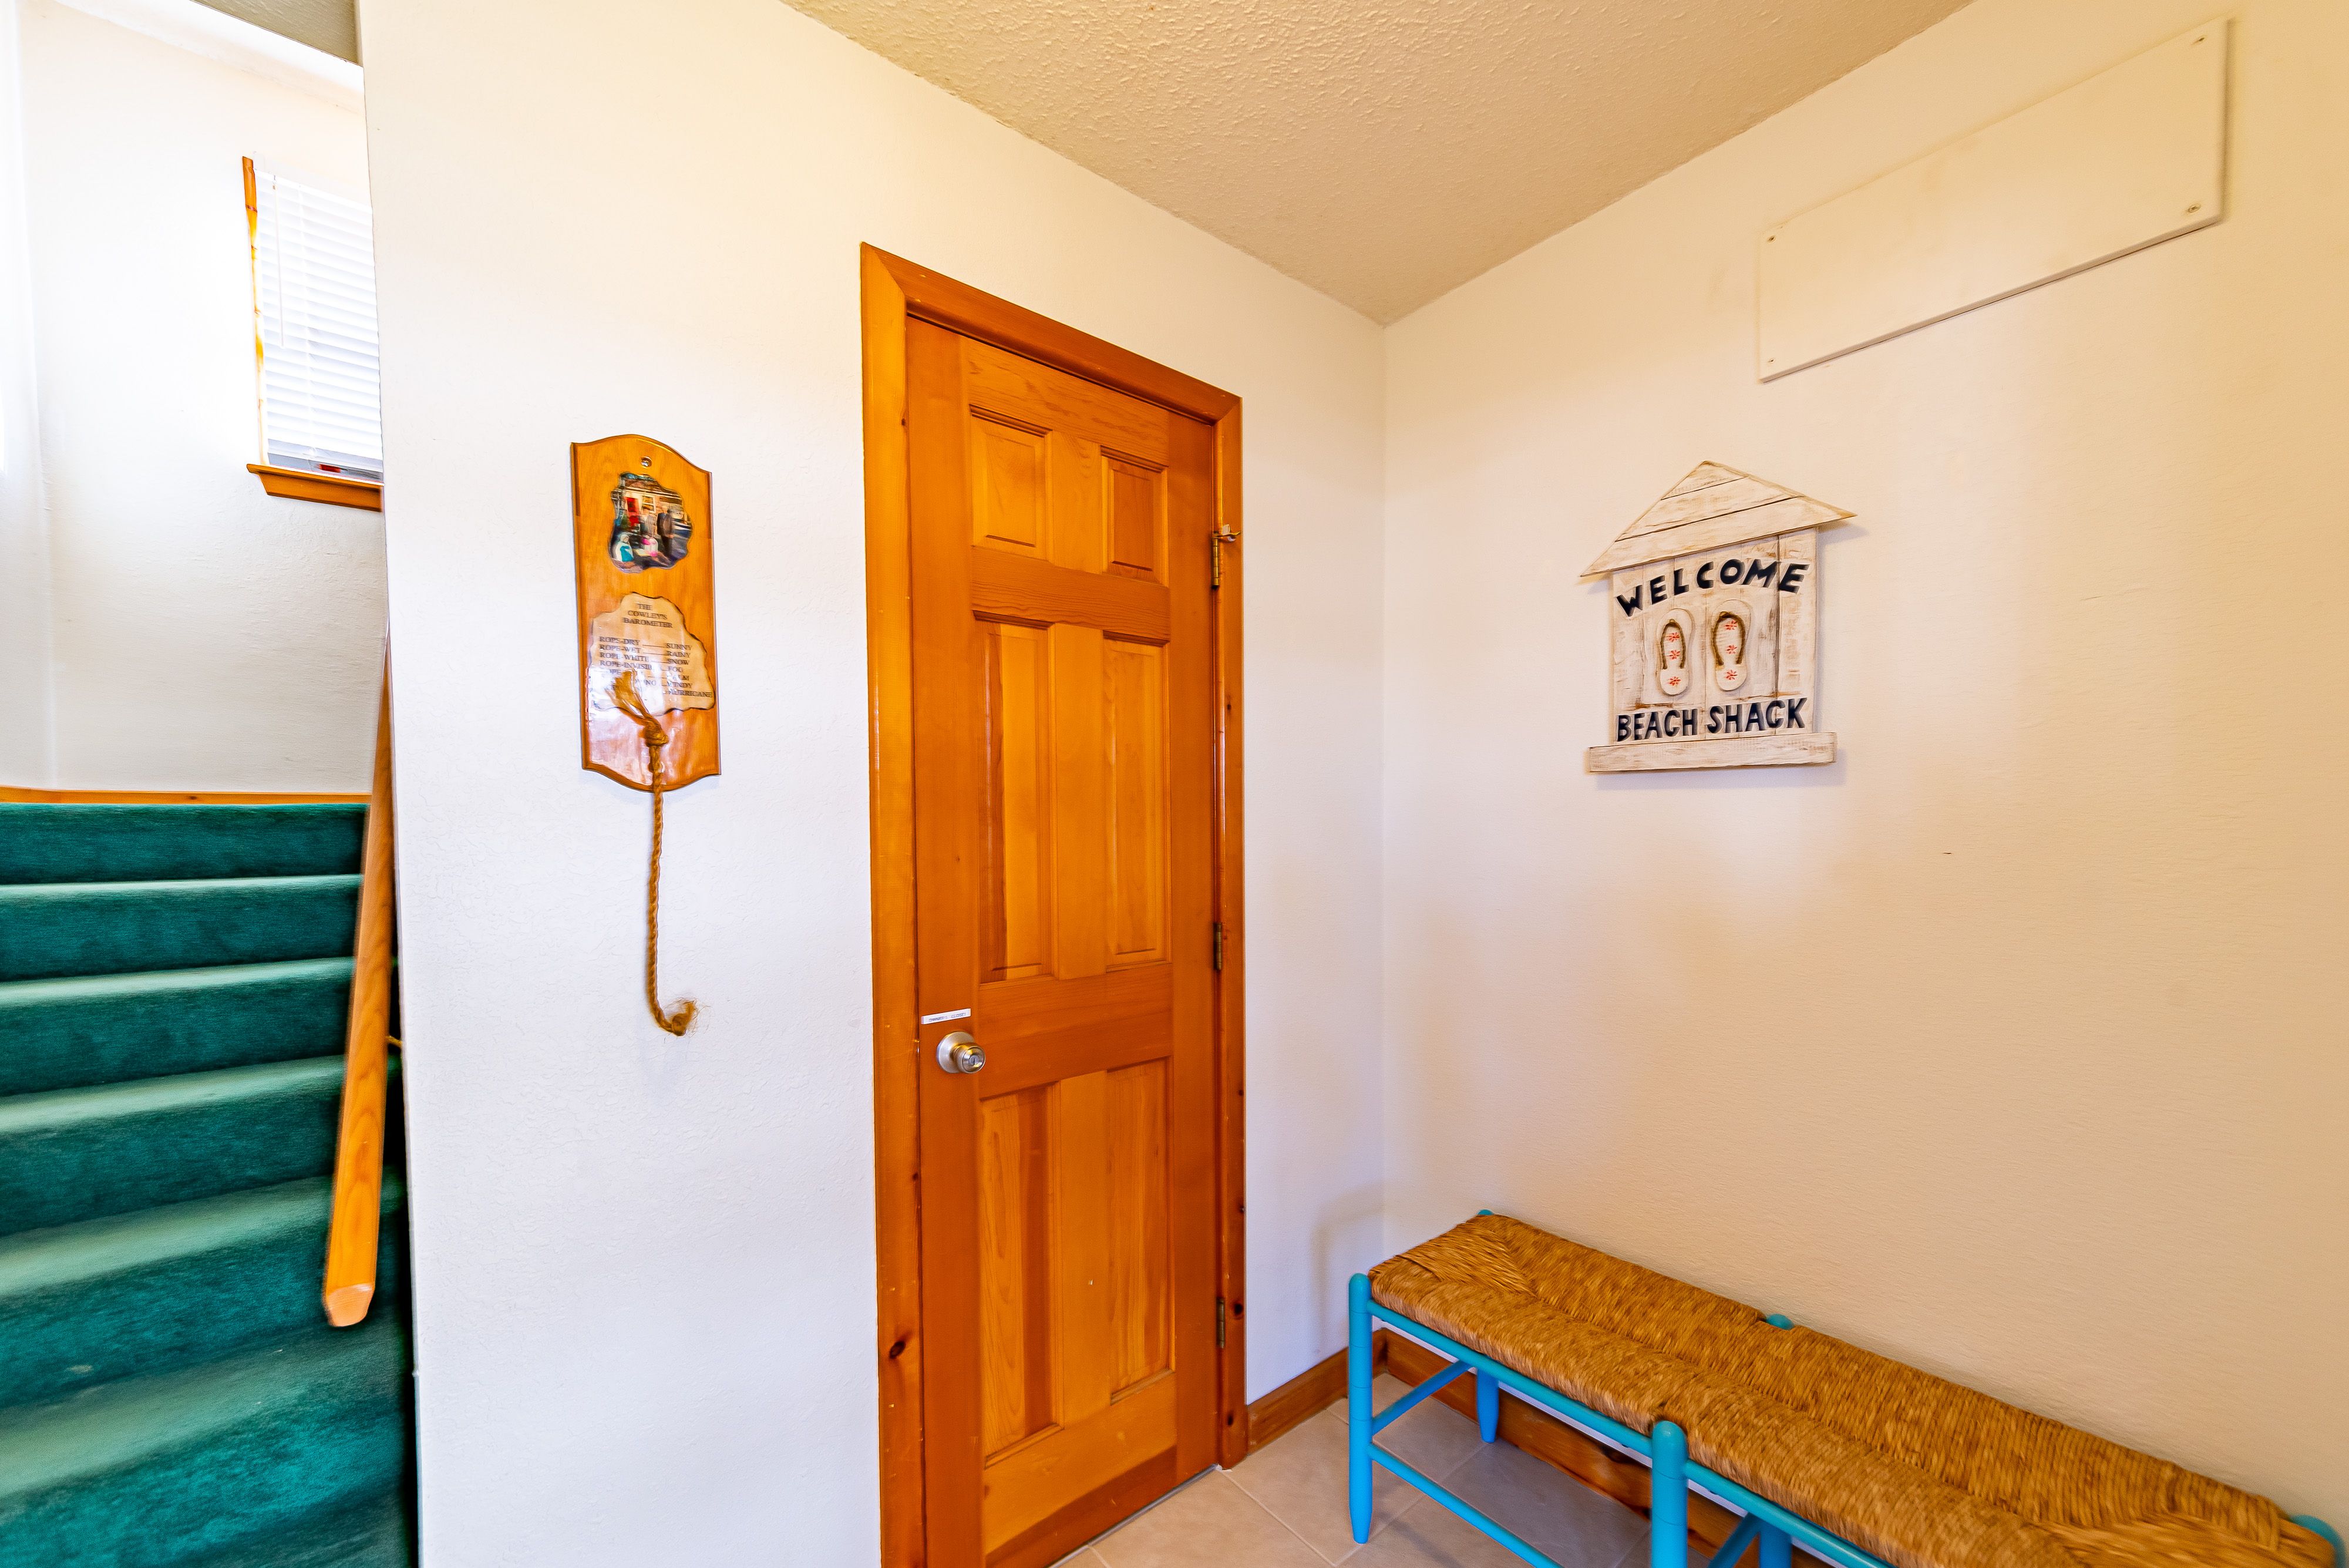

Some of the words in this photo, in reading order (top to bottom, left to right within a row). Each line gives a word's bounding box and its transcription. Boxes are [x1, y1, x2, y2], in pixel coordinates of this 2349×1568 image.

[1616, 558, 1809, 617] WELCOME
[622, 617, 673, 628] BAROMETER
[1616, 708, 1698, 742] BEACH
[1705, 697, 1808, 733] SHACK
